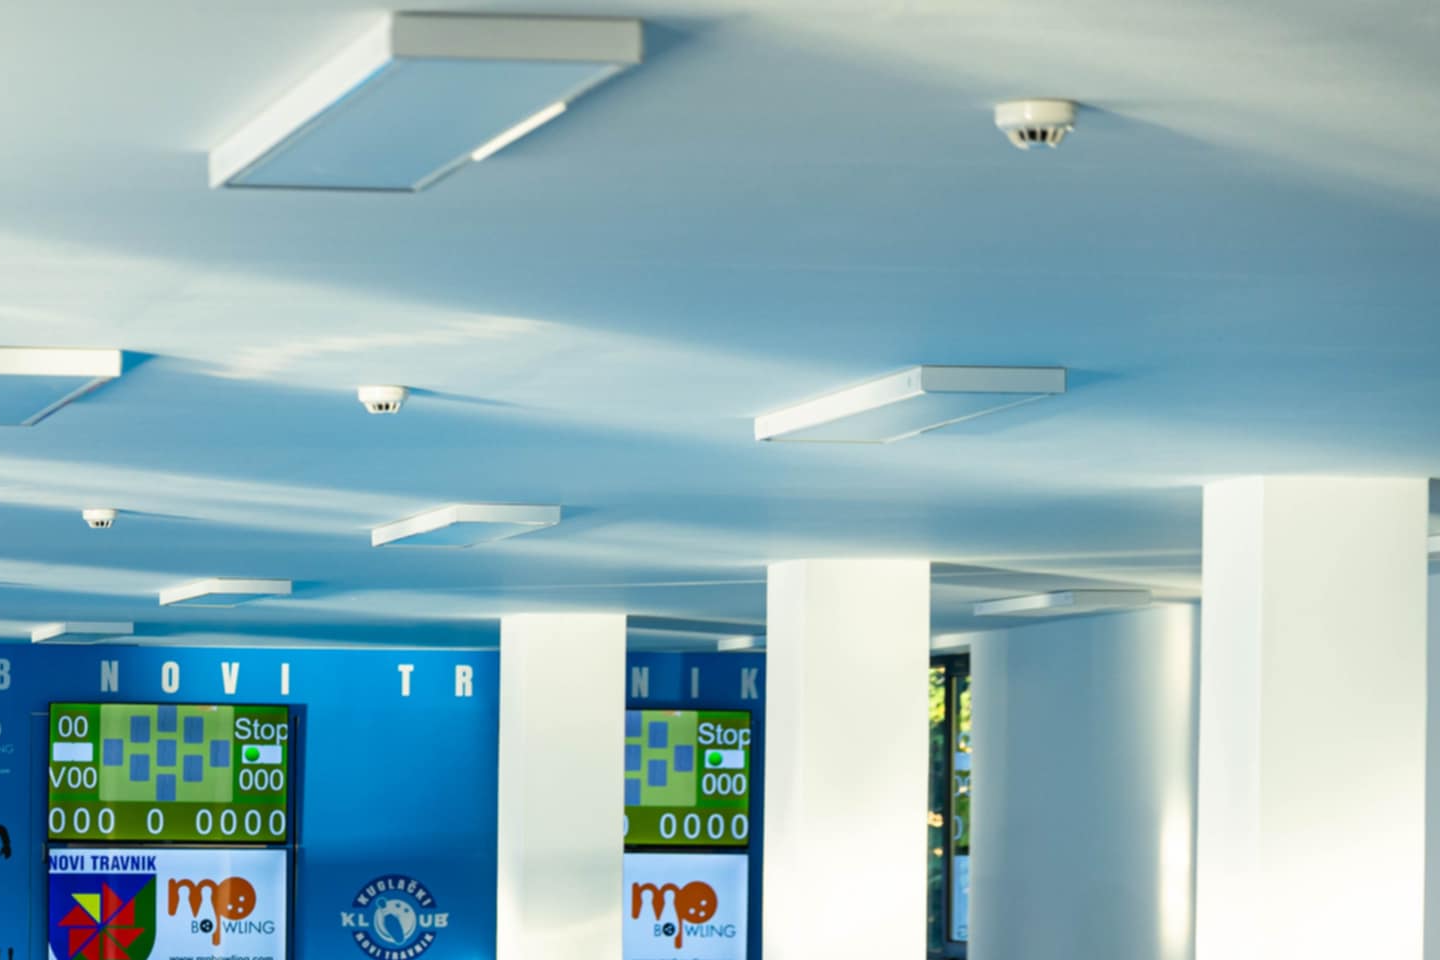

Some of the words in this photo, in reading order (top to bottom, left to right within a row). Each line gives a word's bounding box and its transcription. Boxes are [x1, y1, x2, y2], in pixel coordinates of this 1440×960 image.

[100, 660, 290, 695] NOVI
[398, 664, 758, 699] TRNIK
[58, 715, 89, 738] 00
[234, 717, 288, 744] Stop
[698, 722, 751, 749] Stop
[49, 766, 97, 789] V00
[239, 769, 284, 791] 000
[702, 774, 746, 795] 000
[49, 855, 85, 870] NOVI
[92, 855, 157, 871] TRAVNIK
[191, 919, 275, 935] BOWLING
